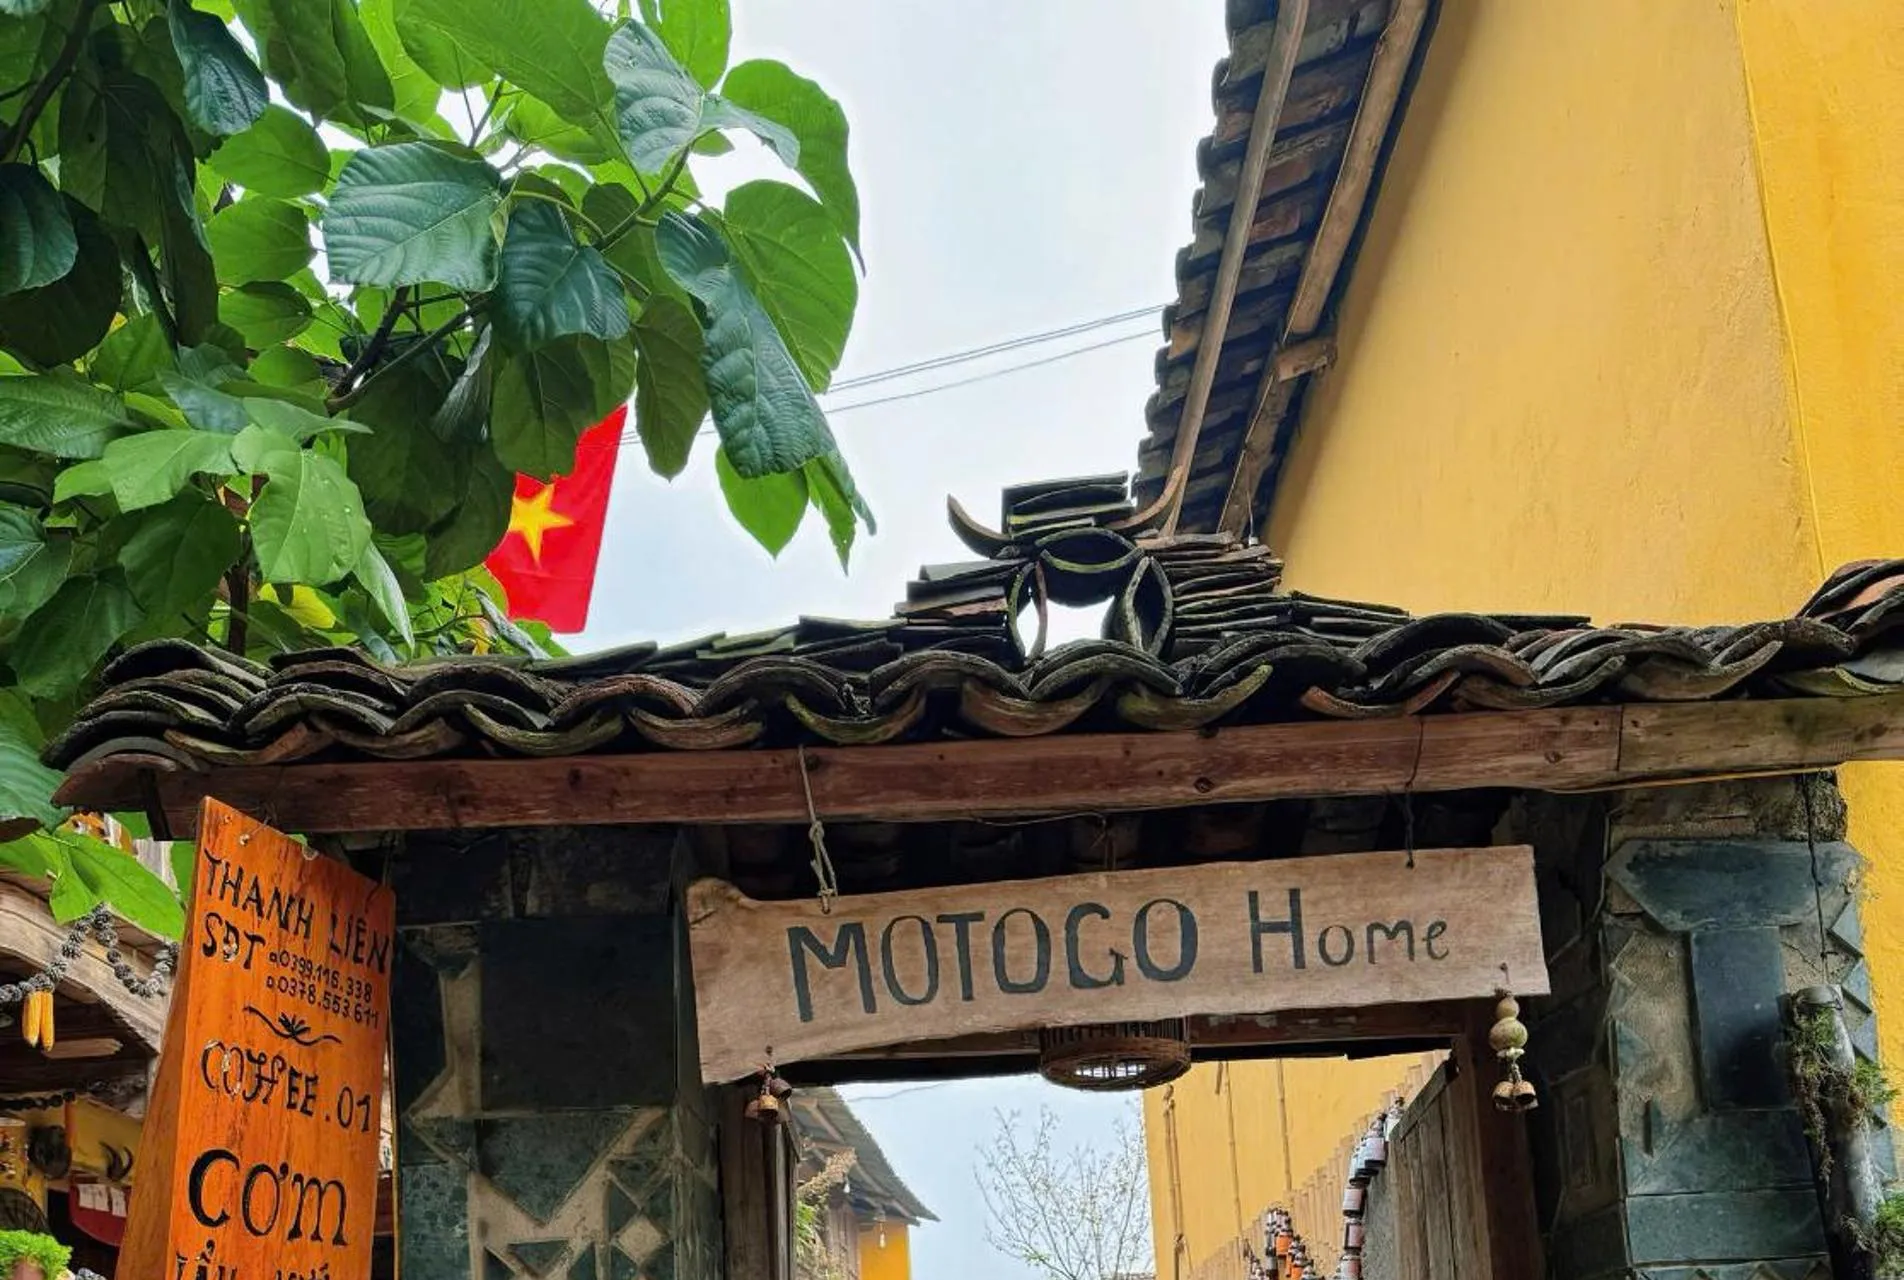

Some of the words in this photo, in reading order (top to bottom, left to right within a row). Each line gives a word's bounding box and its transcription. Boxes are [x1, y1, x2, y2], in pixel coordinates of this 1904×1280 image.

[204, 848, 315, 939] THANH
[787, 898, 1199, 1023] MOTOGO
[1248, 888, 1449, 973] Home
